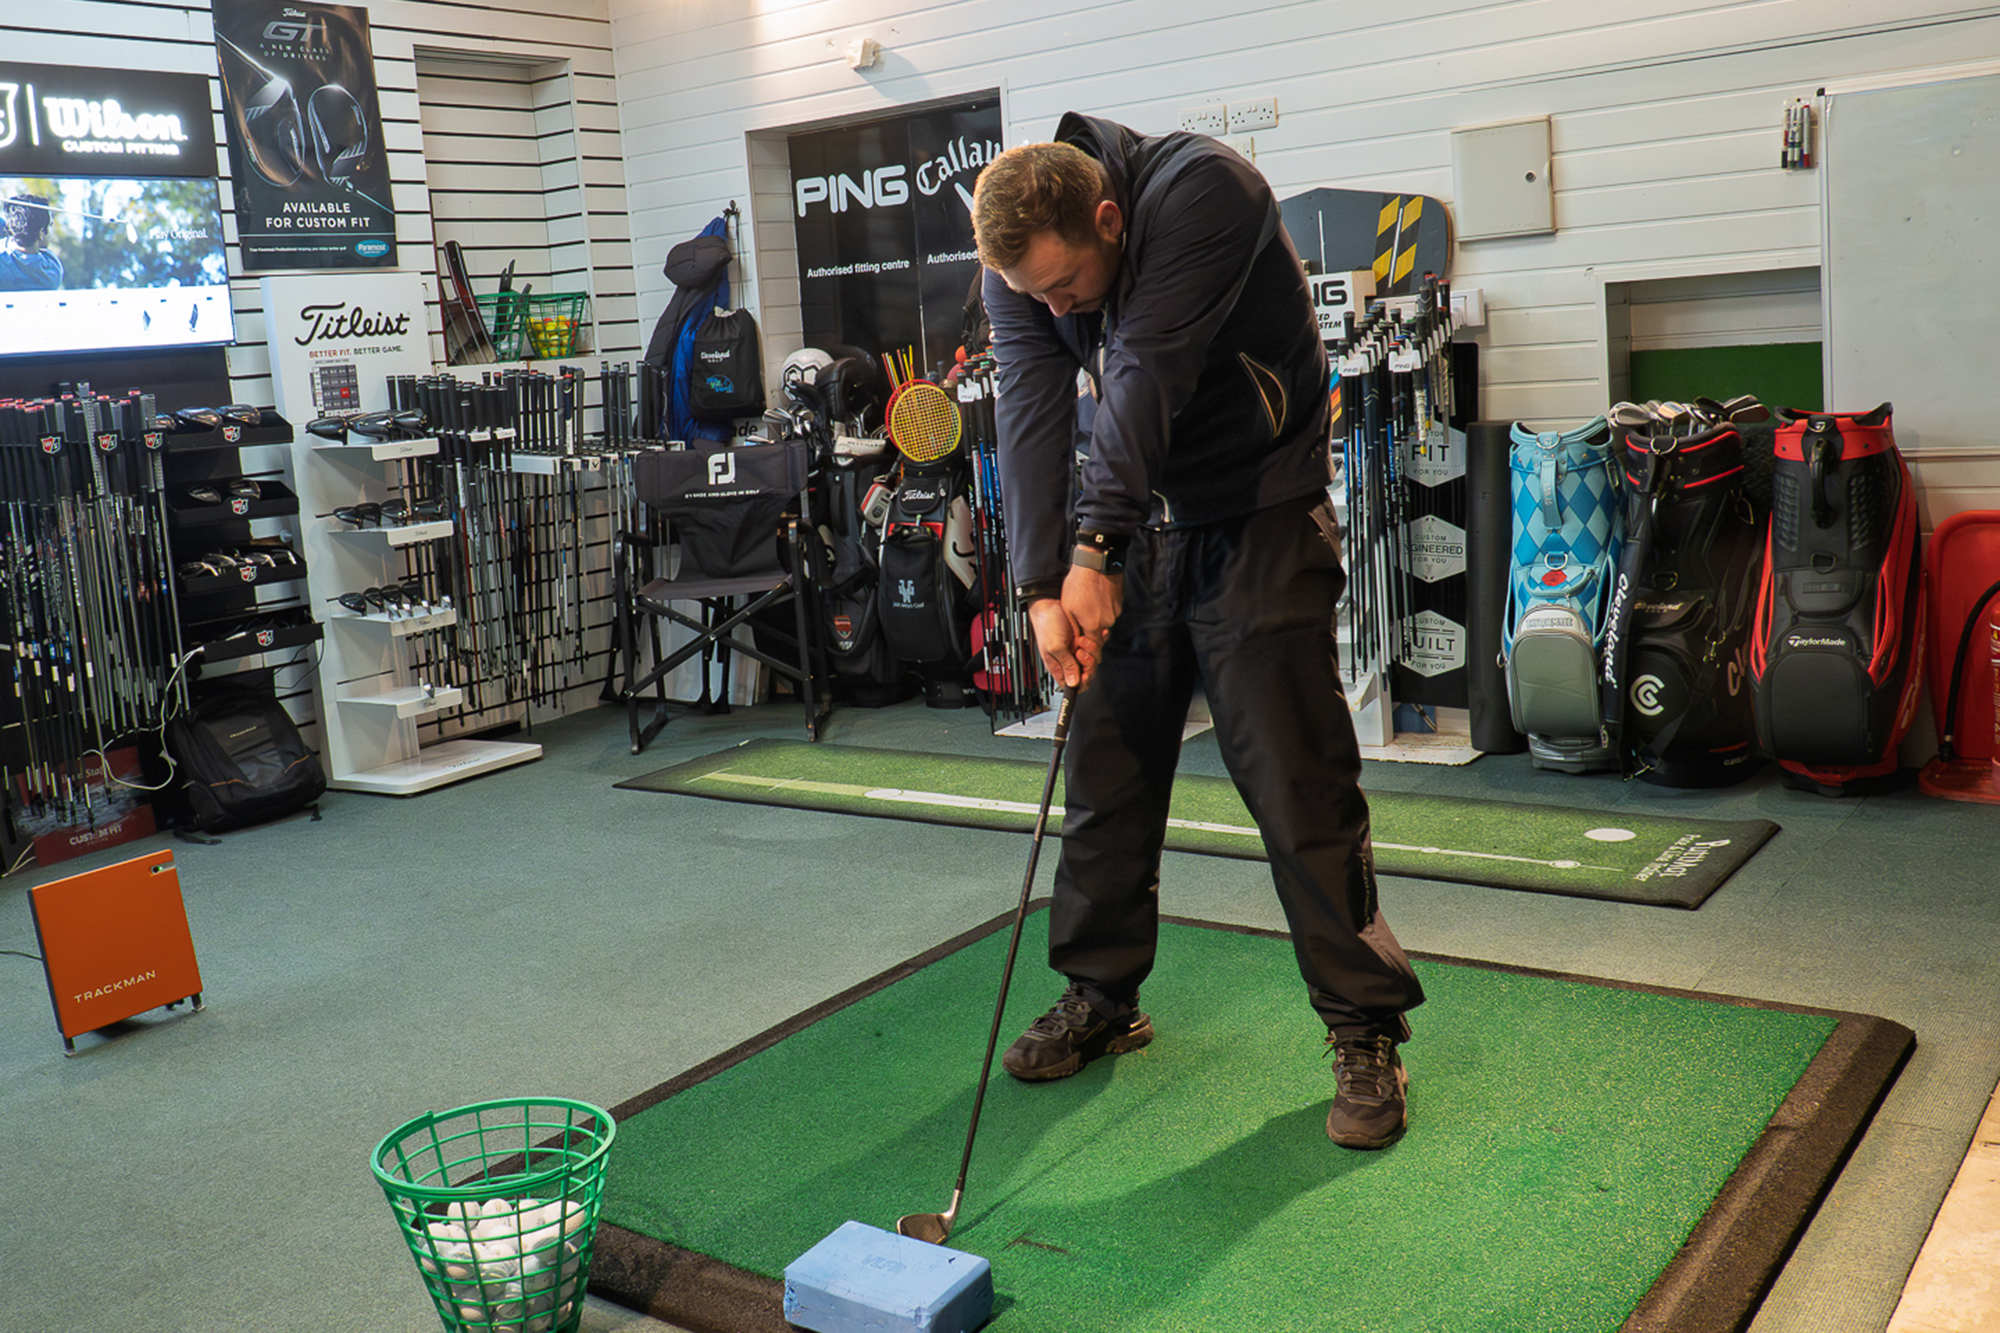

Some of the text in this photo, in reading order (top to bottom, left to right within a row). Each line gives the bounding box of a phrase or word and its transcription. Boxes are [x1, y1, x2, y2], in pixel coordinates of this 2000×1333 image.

[62, 140, 124, 154] CUSTOM
[796, 164, 910, 218] PING
[282, 202, 351, 213] AVAILABLE
[265, 217, 370, 228] FOR CUSTOM FIT
[927, 250, 978, 265] Authorised
[807, 259, 910, 279] Authorised fitting centre
[294, 301, 411, 346] Titleist
[309, 350, 338, 359] BETTER
[353, 347, 381, 355] BETTER
[1411, 444, 1450, 461] FIT
[1414, 533, 1447, 541] CUSTOM
[1431, 556, 1447, 564] YOU
[1605, 573, 1628, 688] Cleveland
[1788, 635, 1846, 648] TaylorMade
[74, 970, 157, 1003] TRACKMAN
